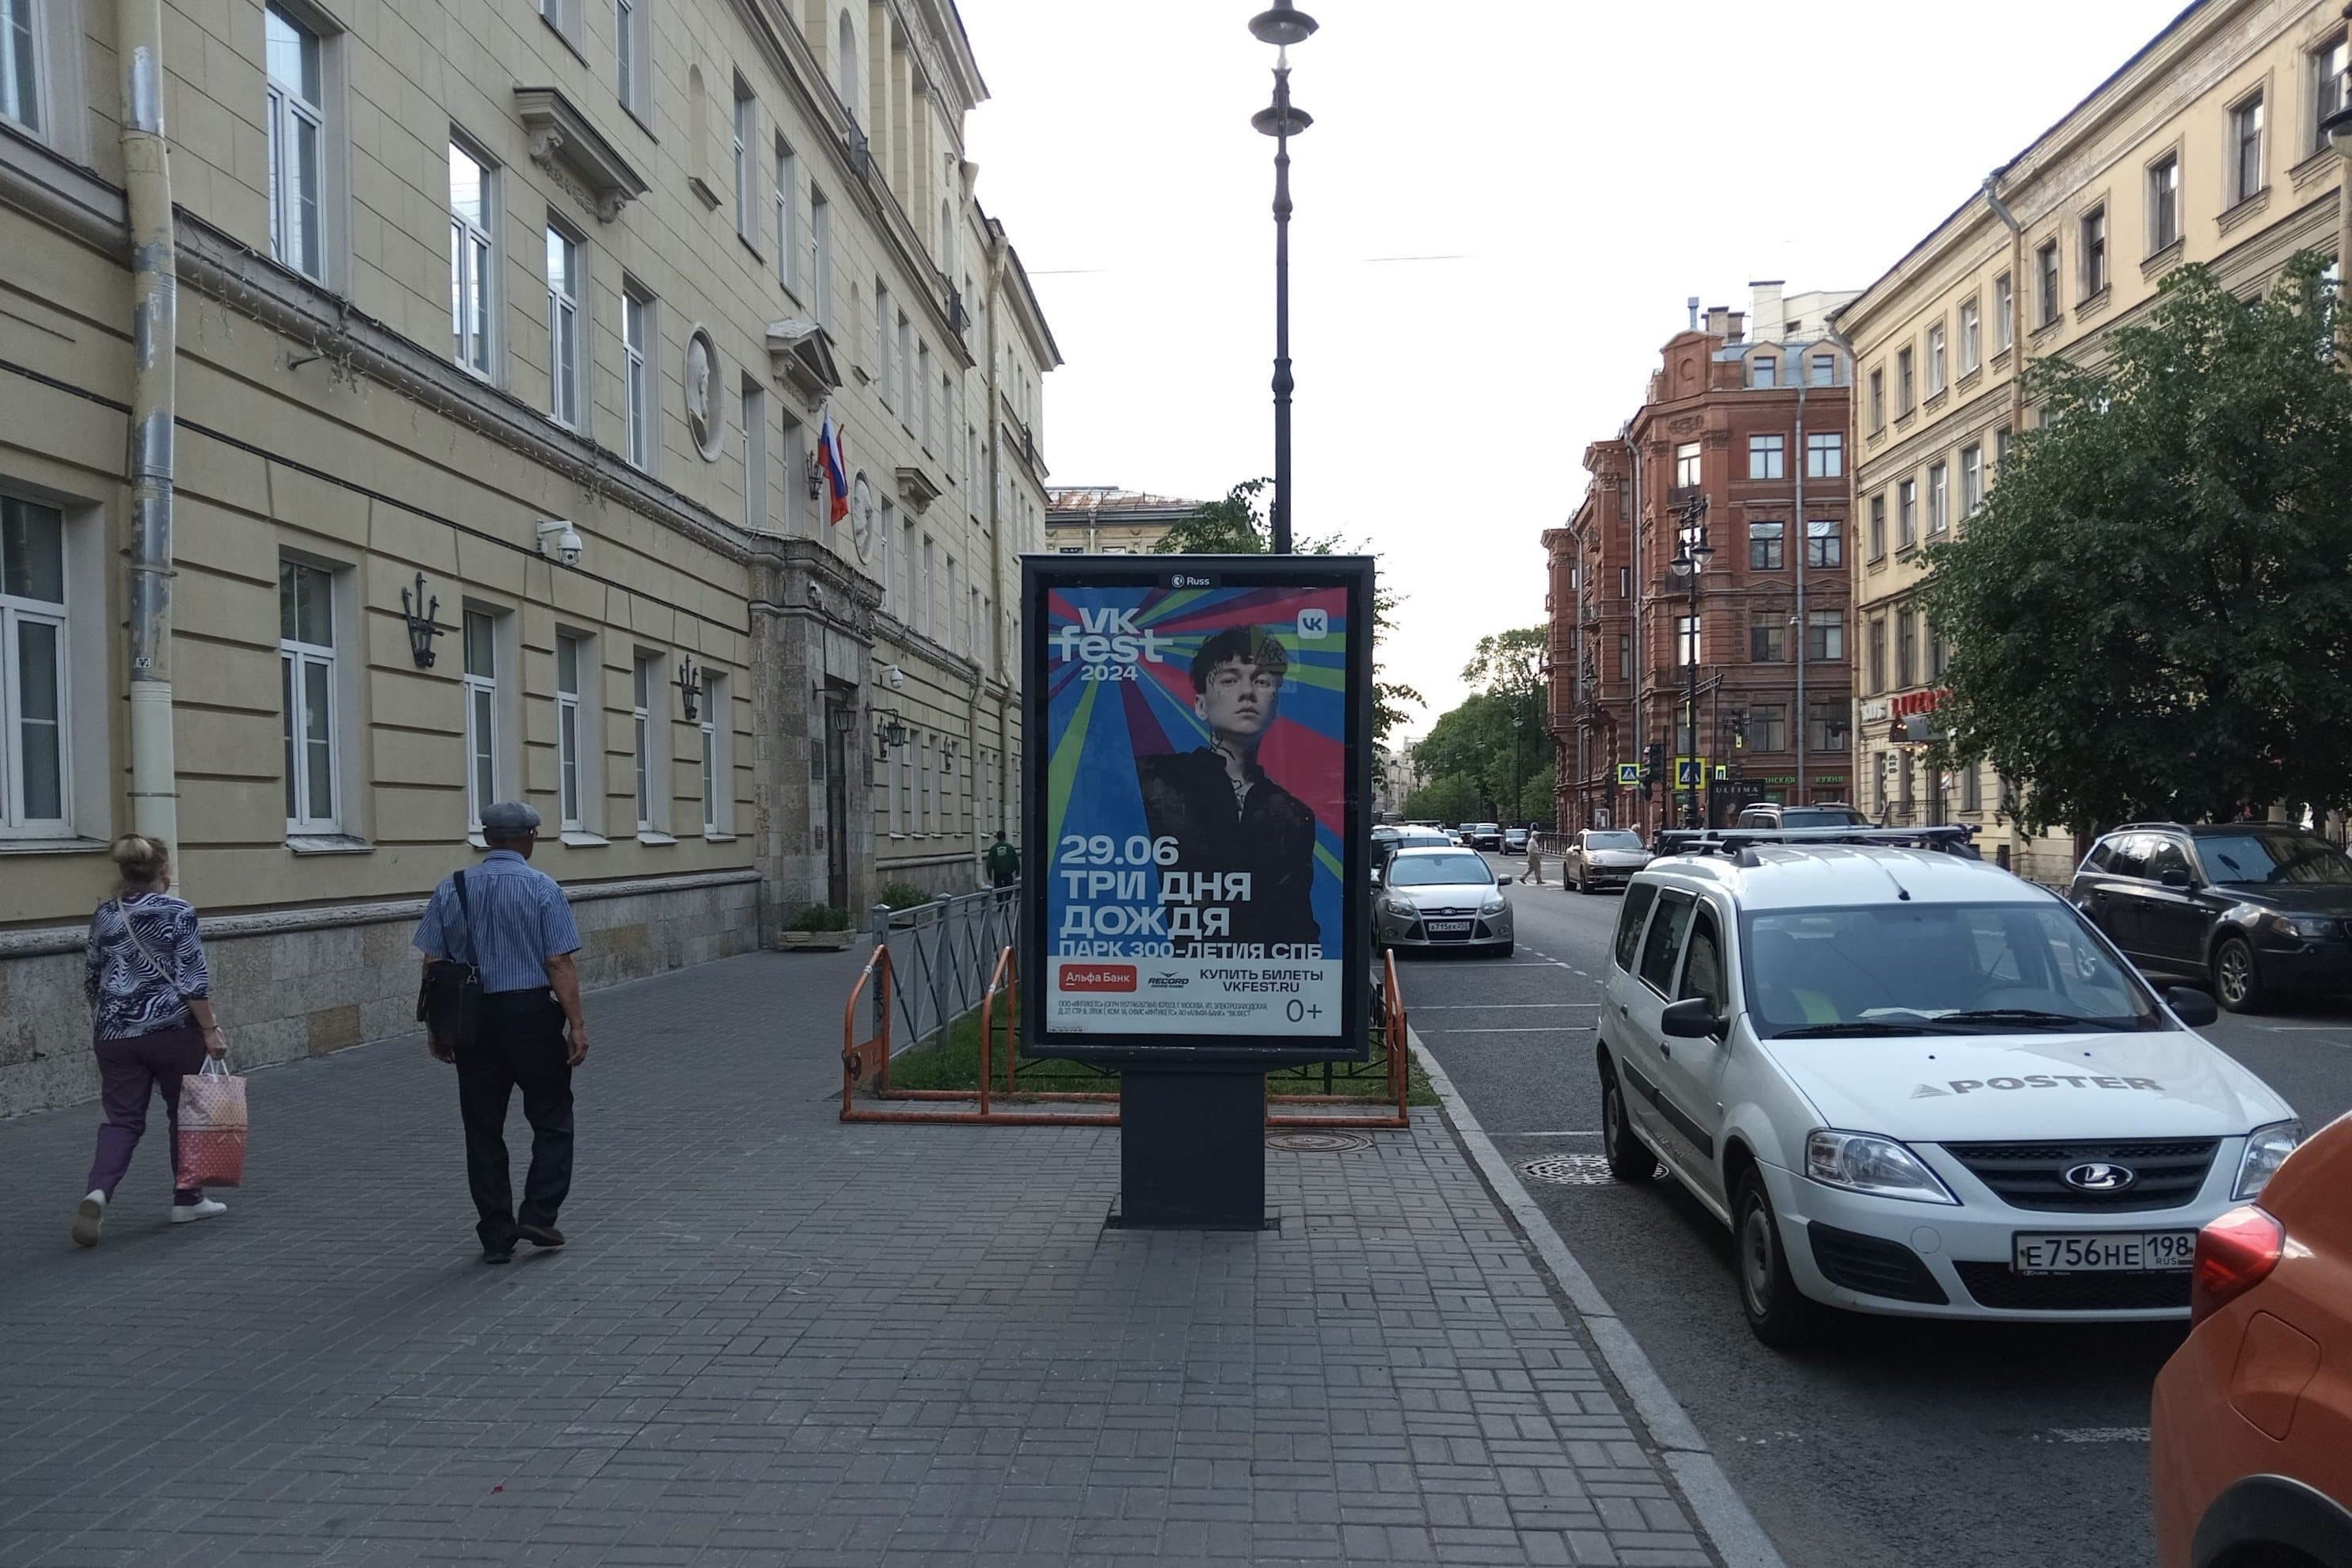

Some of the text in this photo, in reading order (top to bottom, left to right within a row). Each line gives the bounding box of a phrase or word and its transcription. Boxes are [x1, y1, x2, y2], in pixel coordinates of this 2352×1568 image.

[1187, 577, 1210, 586] Russ
[1078, 607, 1141, 634] VK
[1302, 616, 1323, 632] VK
[1049, 625, 1174, 664] fest
[1080, 664, 1138, 682] 2024
[1060, 835, 1180, 866] 29.06
[1060, 870, 1252, 904] ТРИ ДНЯ
[1060, 905, 1230, 940] ДОЖДЯ
[1059, 941, 1323, 961] ПАРК 300-ЛЕТИЯ СПБ
[1066, 972, 1130, 985] Альфа Банк
[1200, 969, 1323, 981] КУПИТЬ БИЛЕТЫ
[1223, 981, 1300, 993] VKFEST.RU
[1286, 999, 1323, 1023] 0+
[1948, 1075, 2166, 1094] POSTER
[2026, 1236, 2189, 1267] Е756НЕ 198
[2155, 1256, 2177, 1265] RUS
